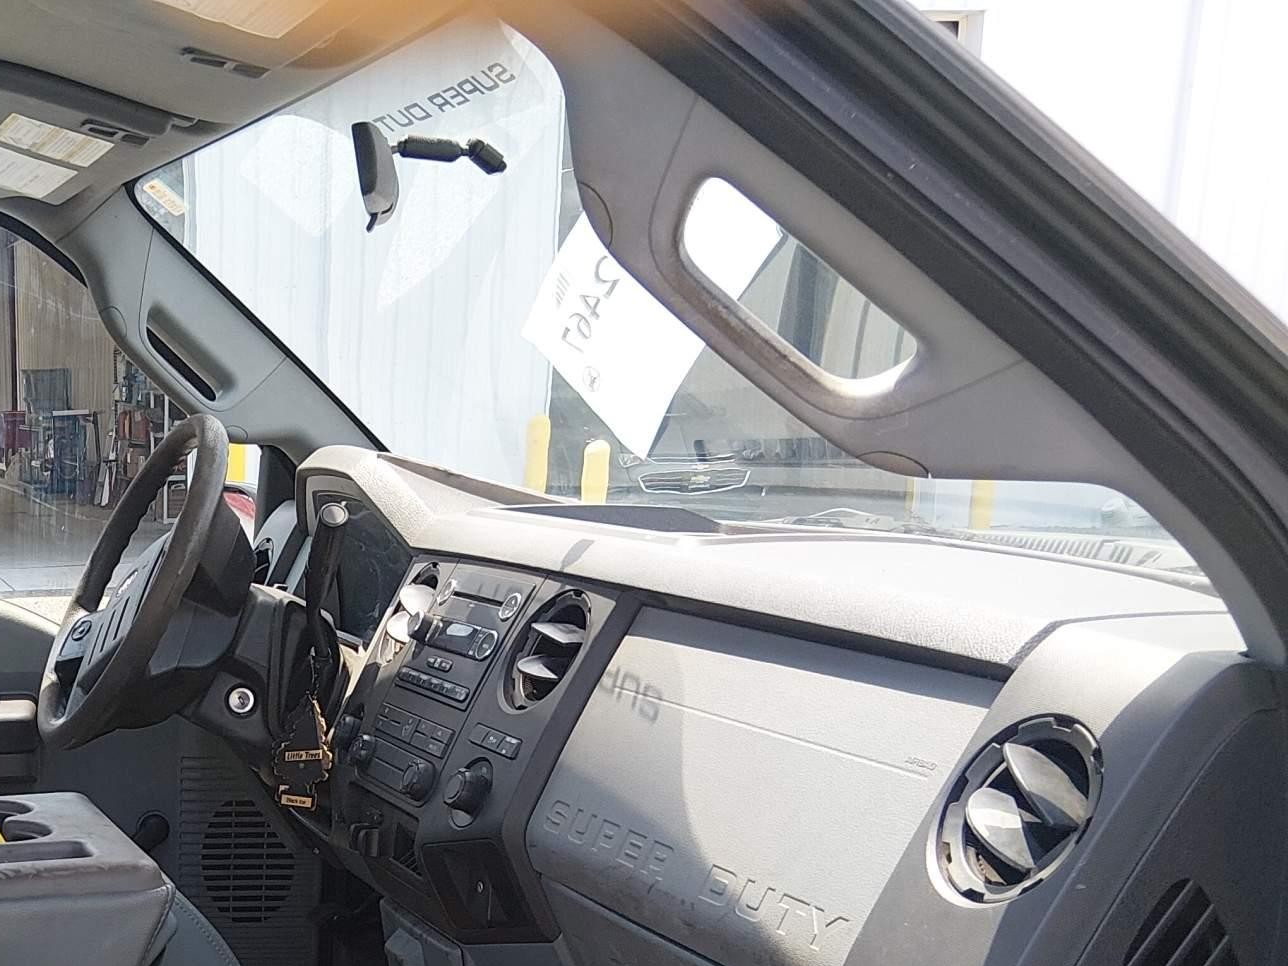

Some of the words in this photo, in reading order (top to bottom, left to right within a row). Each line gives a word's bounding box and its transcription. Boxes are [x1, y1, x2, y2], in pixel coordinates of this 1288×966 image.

[286, 751, 304, 761] Little
[543, 799, 674, 881] SUPER
[698, 863, 850, 951] DUTY
